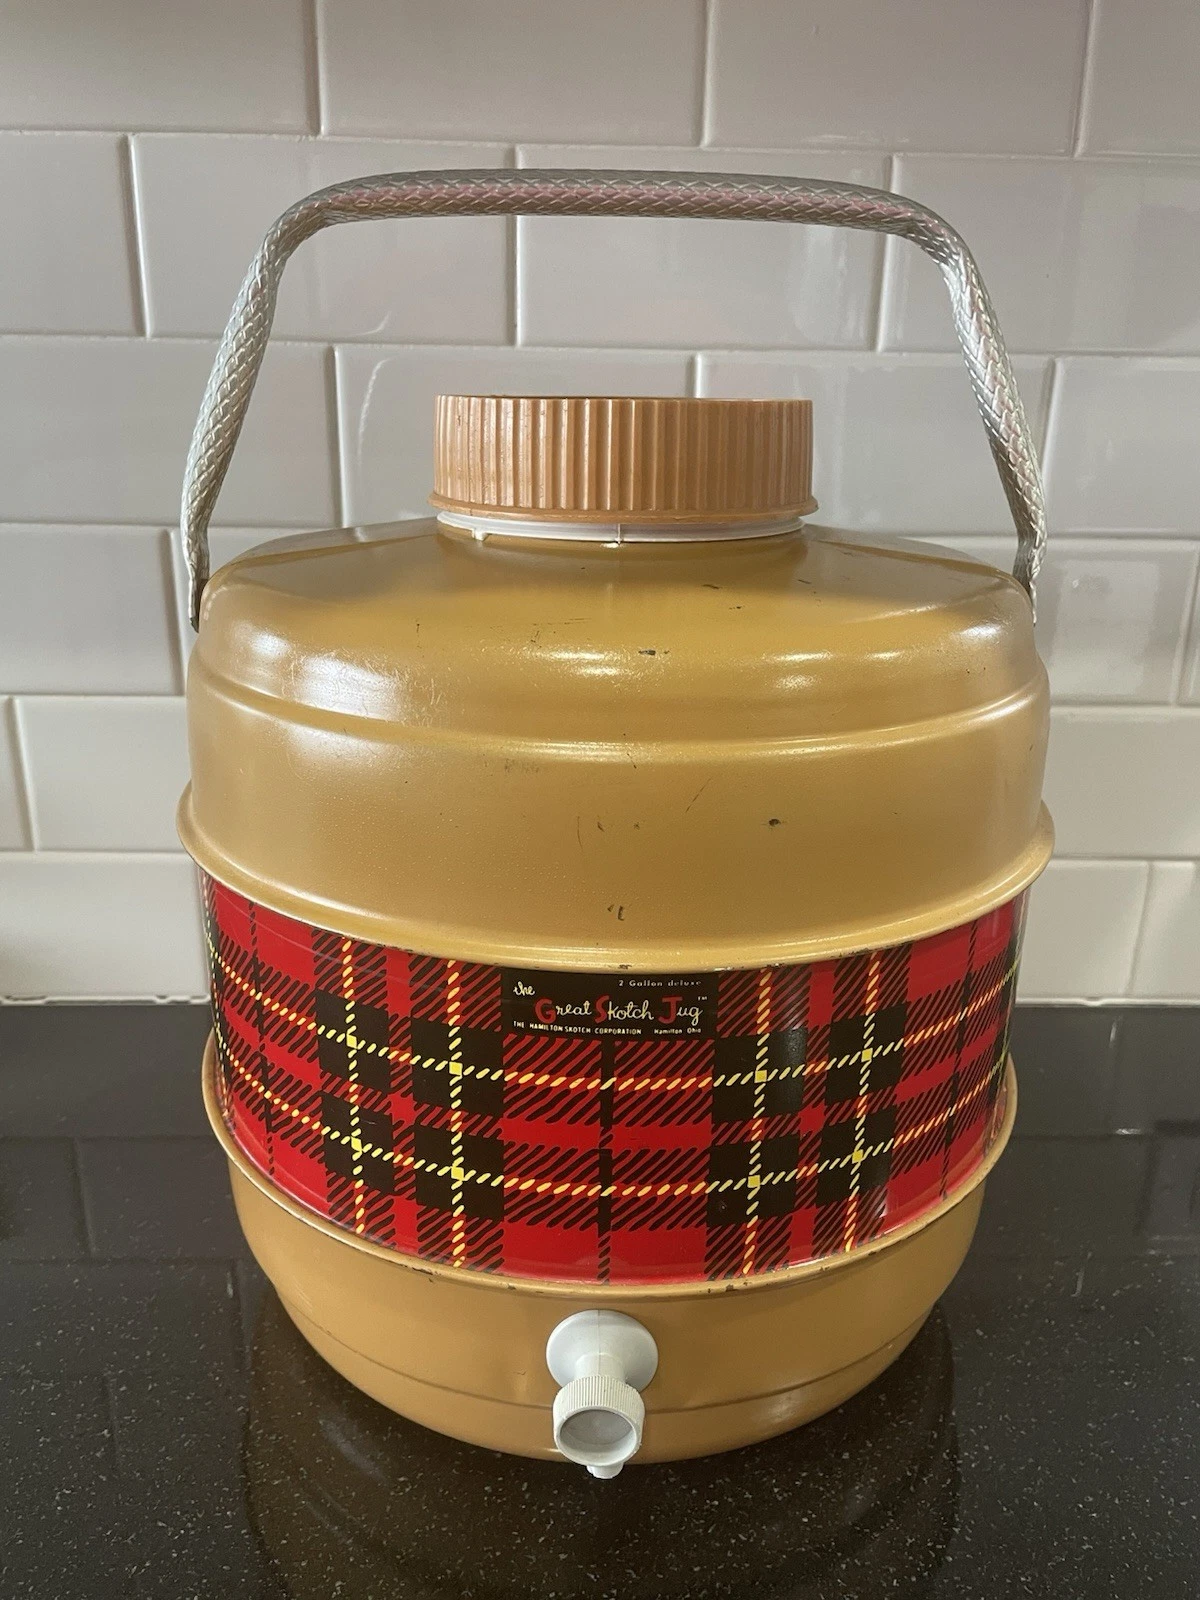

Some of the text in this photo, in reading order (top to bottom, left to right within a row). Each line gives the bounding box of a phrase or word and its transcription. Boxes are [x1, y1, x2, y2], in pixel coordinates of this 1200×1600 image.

[513, 980, 536, 996] the
[628, 979, 663, 987] Gallon
[534, 995, 703, 1026] Great Skotch Jug
[513, 1020, 525, 1029] THE
[529, 1022, 563, 1032] HAMILTON
[564, 1025, 591, 1034] SKOTCH
[594, 1027, 642, 1035] CORPORATION
